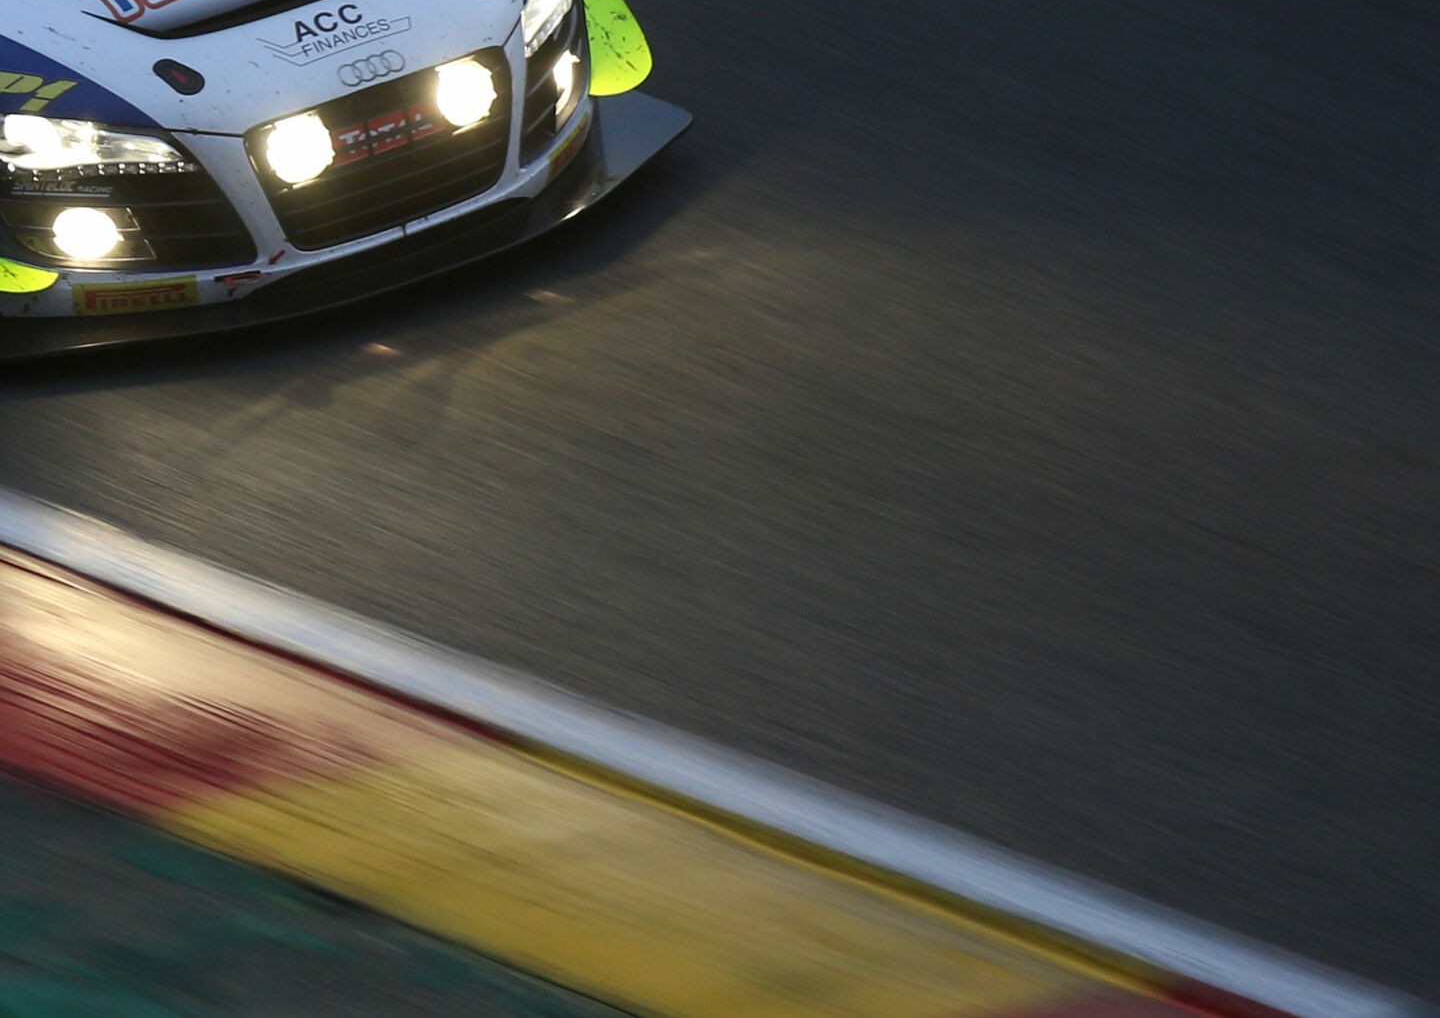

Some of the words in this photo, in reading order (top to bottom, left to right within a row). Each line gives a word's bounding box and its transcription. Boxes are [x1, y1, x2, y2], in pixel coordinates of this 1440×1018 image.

[293, 4, 363, 44] ACC
[300, 18, 391, 57] FINANCES
[85, 284, 186, 310] PIRELLI
